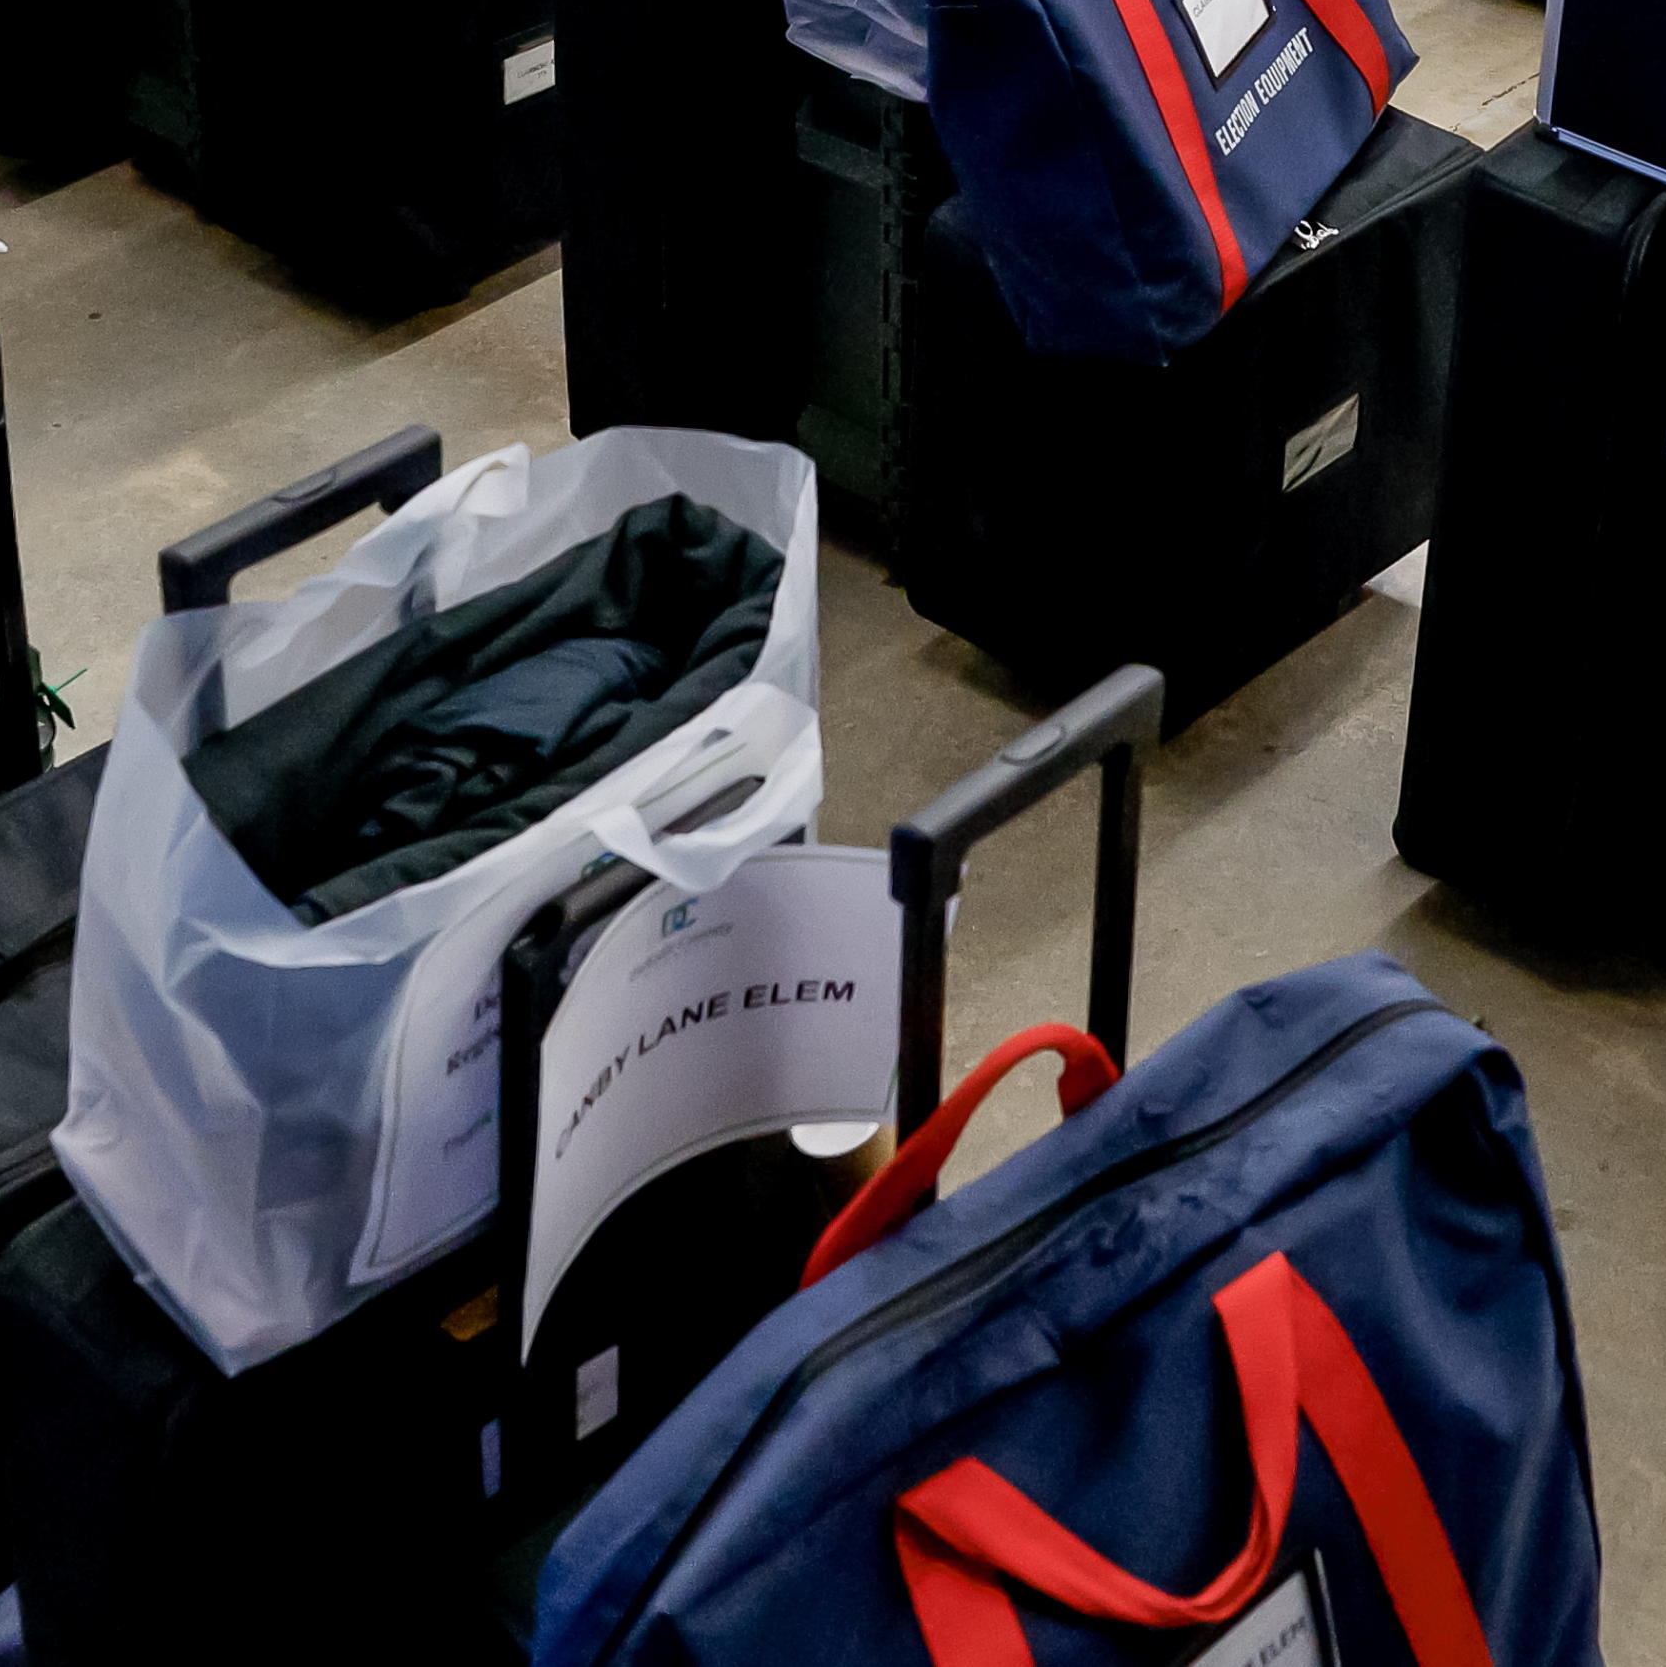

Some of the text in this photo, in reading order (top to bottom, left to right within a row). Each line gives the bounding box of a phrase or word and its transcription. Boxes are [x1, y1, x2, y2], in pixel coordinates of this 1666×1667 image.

[1214, 26, 1314, 155] ELECTION EQUIPMENT
[553, 980, 856, 1161] CANBY LANE ELEM
